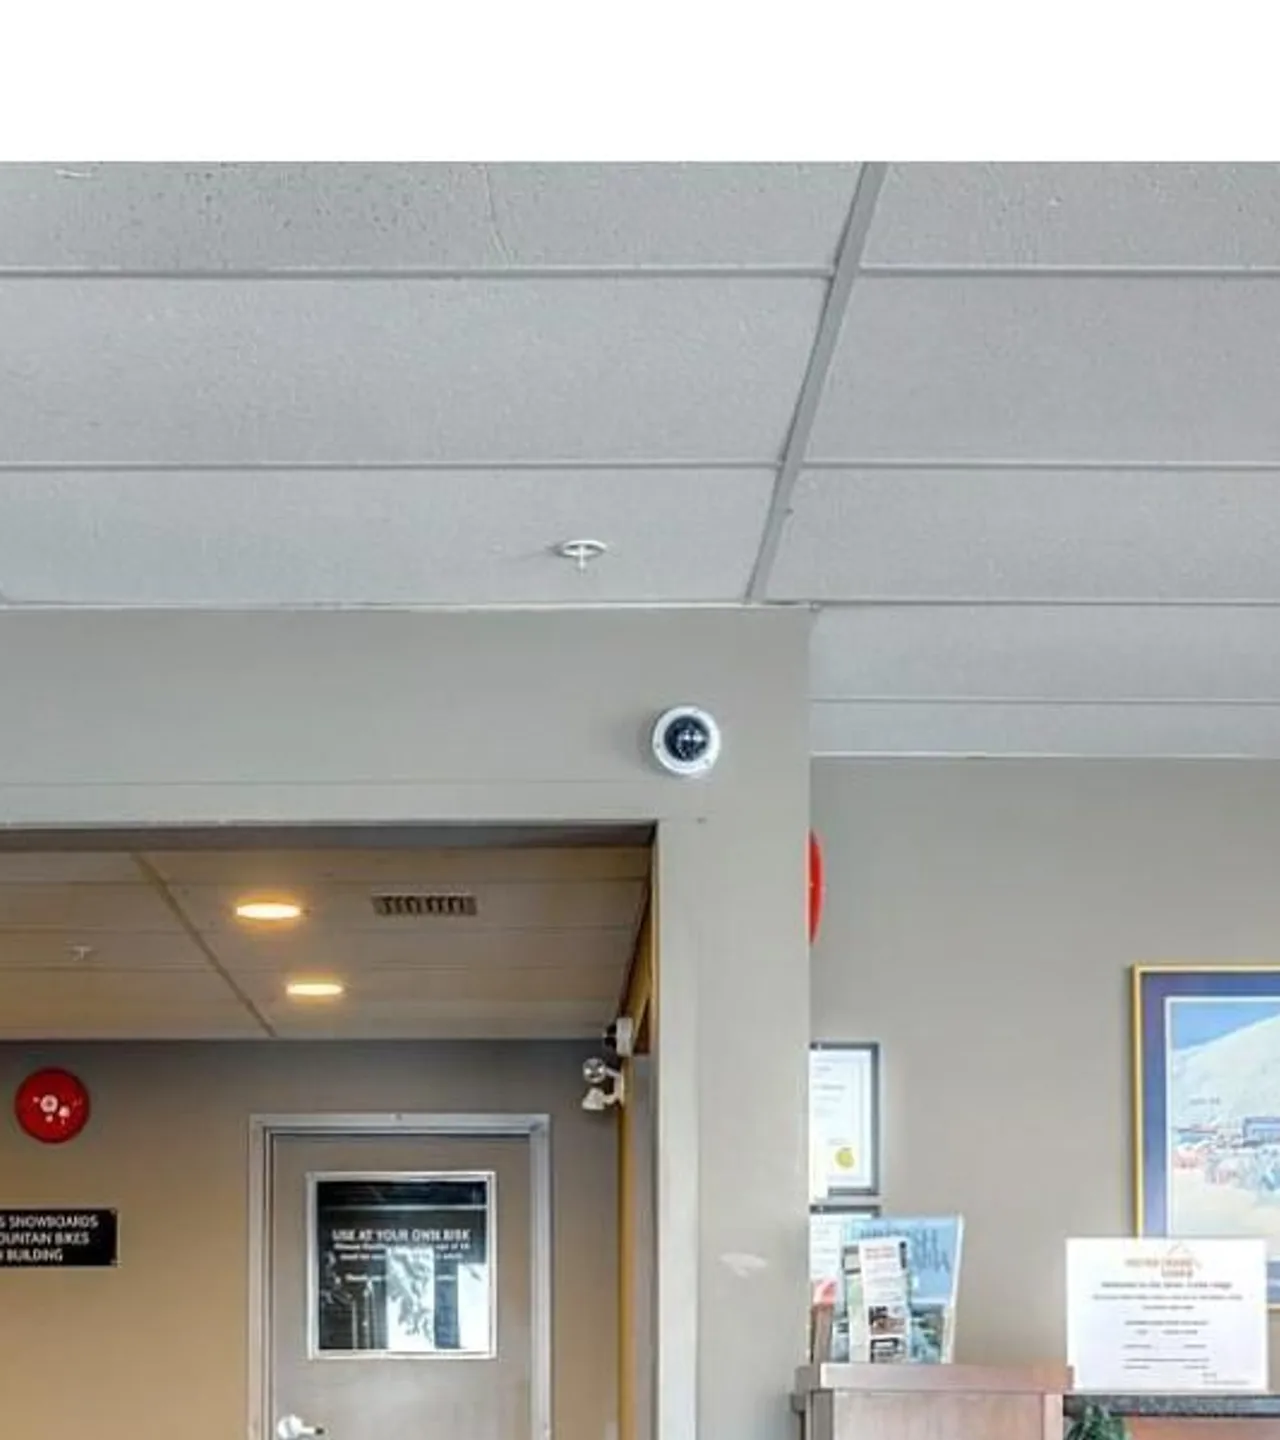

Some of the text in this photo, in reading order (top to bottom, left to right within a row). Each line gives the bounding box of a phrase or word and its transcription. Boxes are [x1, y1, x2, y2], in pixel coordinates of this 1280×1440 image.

[9, 1215, 99, 1229] SNOWBOARDS
[54, 1231, 91, 1245] BIKES
[332, 1229, 471, 1241] USE AT YOUR OWN RISK
[6, 1248, 64, 1262] BUILDING
